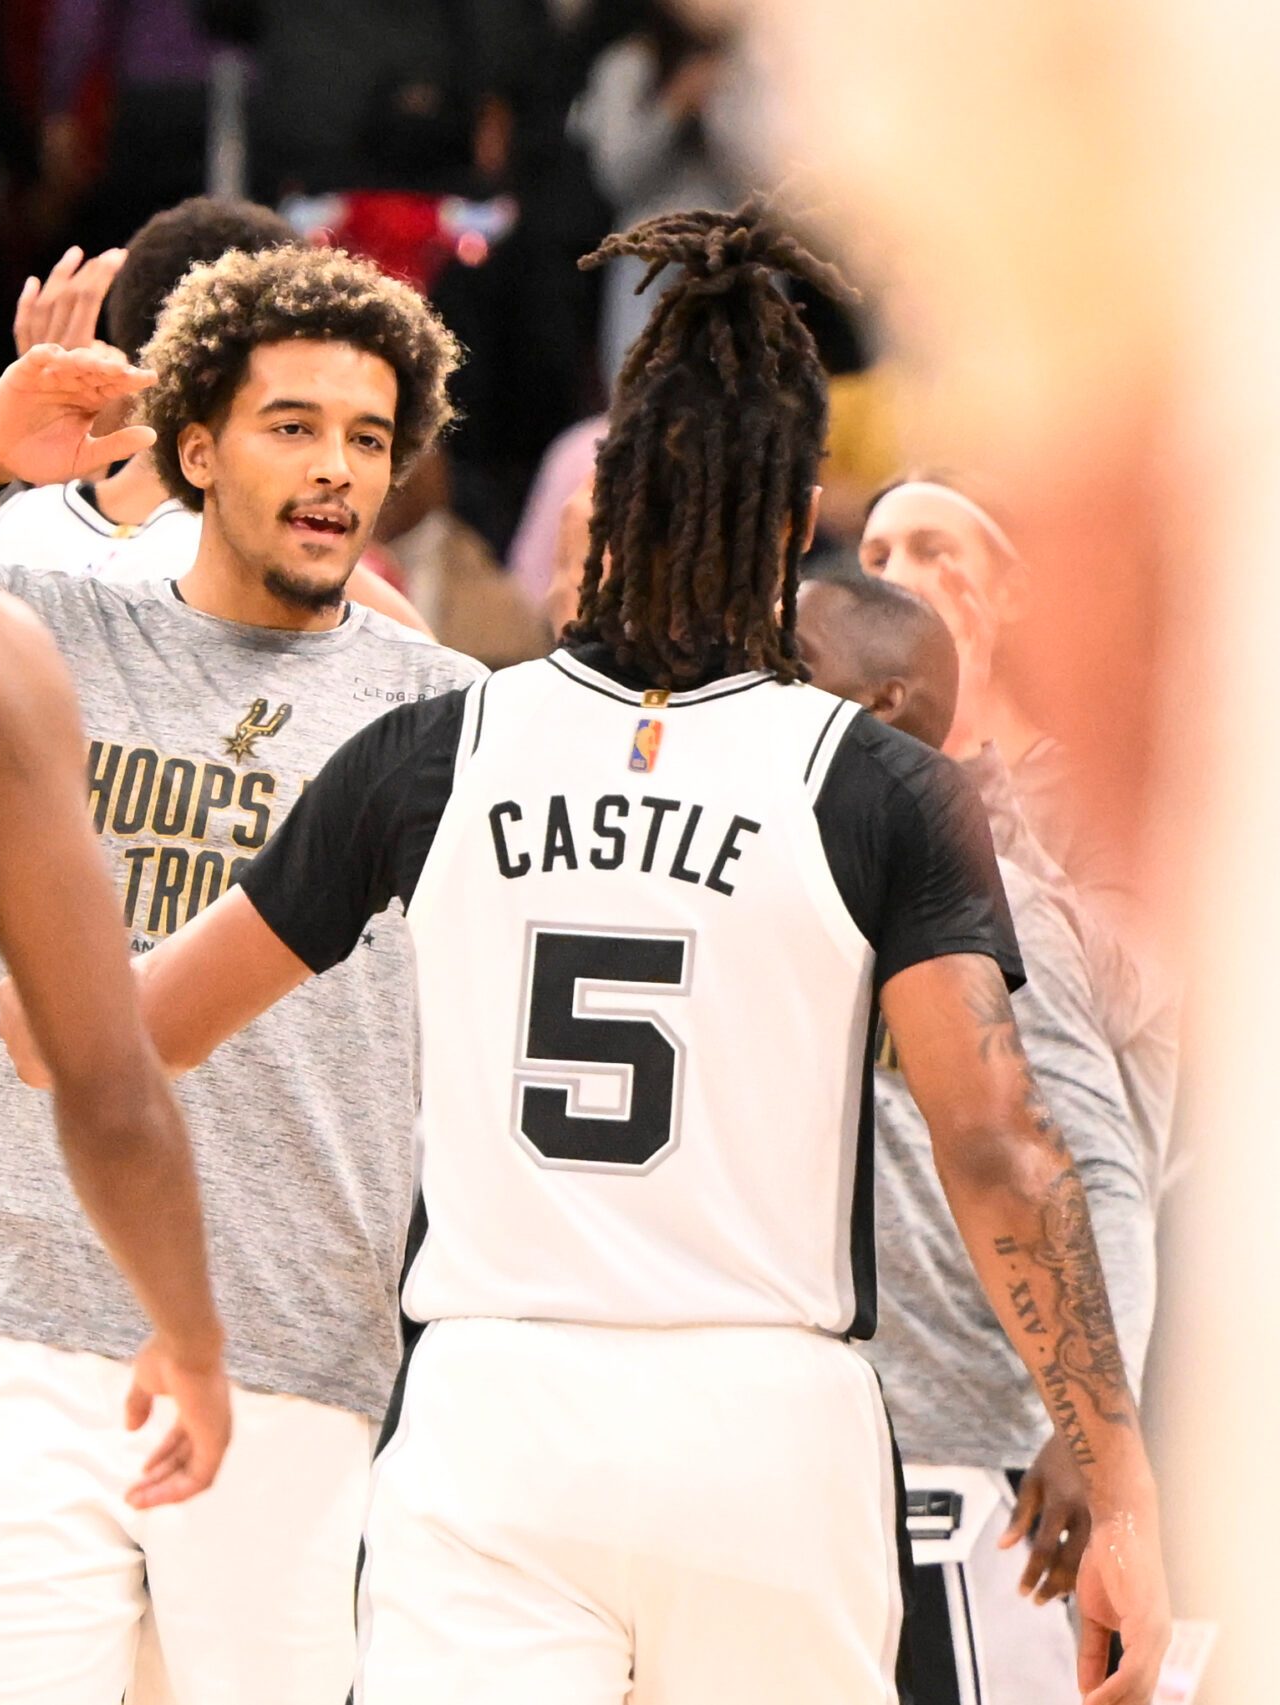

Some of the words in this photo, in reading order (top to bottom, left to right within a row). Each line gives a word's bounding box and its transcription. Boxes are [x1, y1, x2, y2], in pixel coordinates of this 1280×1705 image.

[87, 739, 279, 850] HOOPS
[488, 794, 762, 898] CASTLE
[123, 846, 254, 936] TRO
[510, 919, 697, 1177] 5
[1006, 1278, 1048, 1335] XXV
